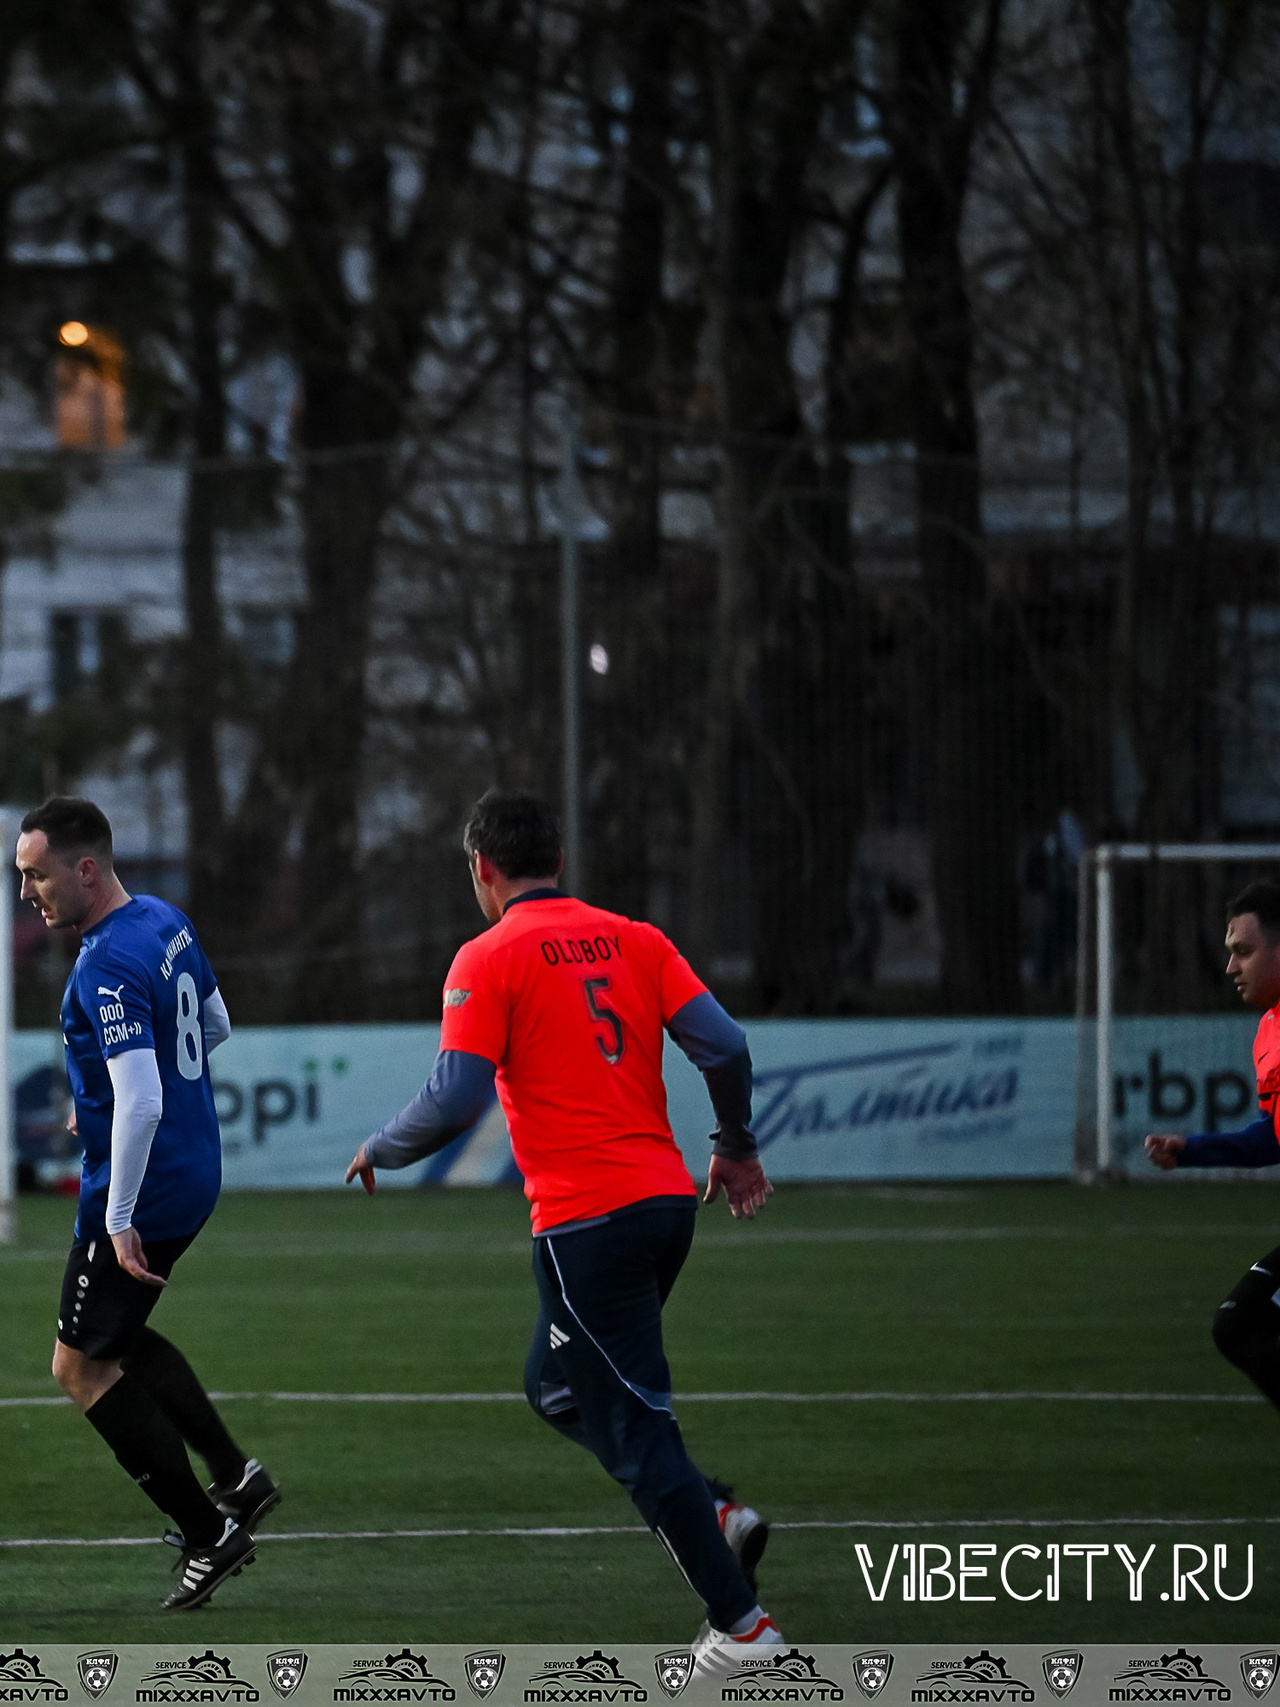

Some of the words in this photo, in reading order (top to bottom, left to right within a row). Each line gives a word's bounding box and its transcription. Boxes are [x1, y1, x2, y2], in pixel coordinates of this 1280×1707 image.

[540, 935, 622, 967] OLDBOY
[176, 971, 203, 1081] 8
[582, 975, 626, 1066] 5
[1113, 1049, 1253, 1134] rbp
